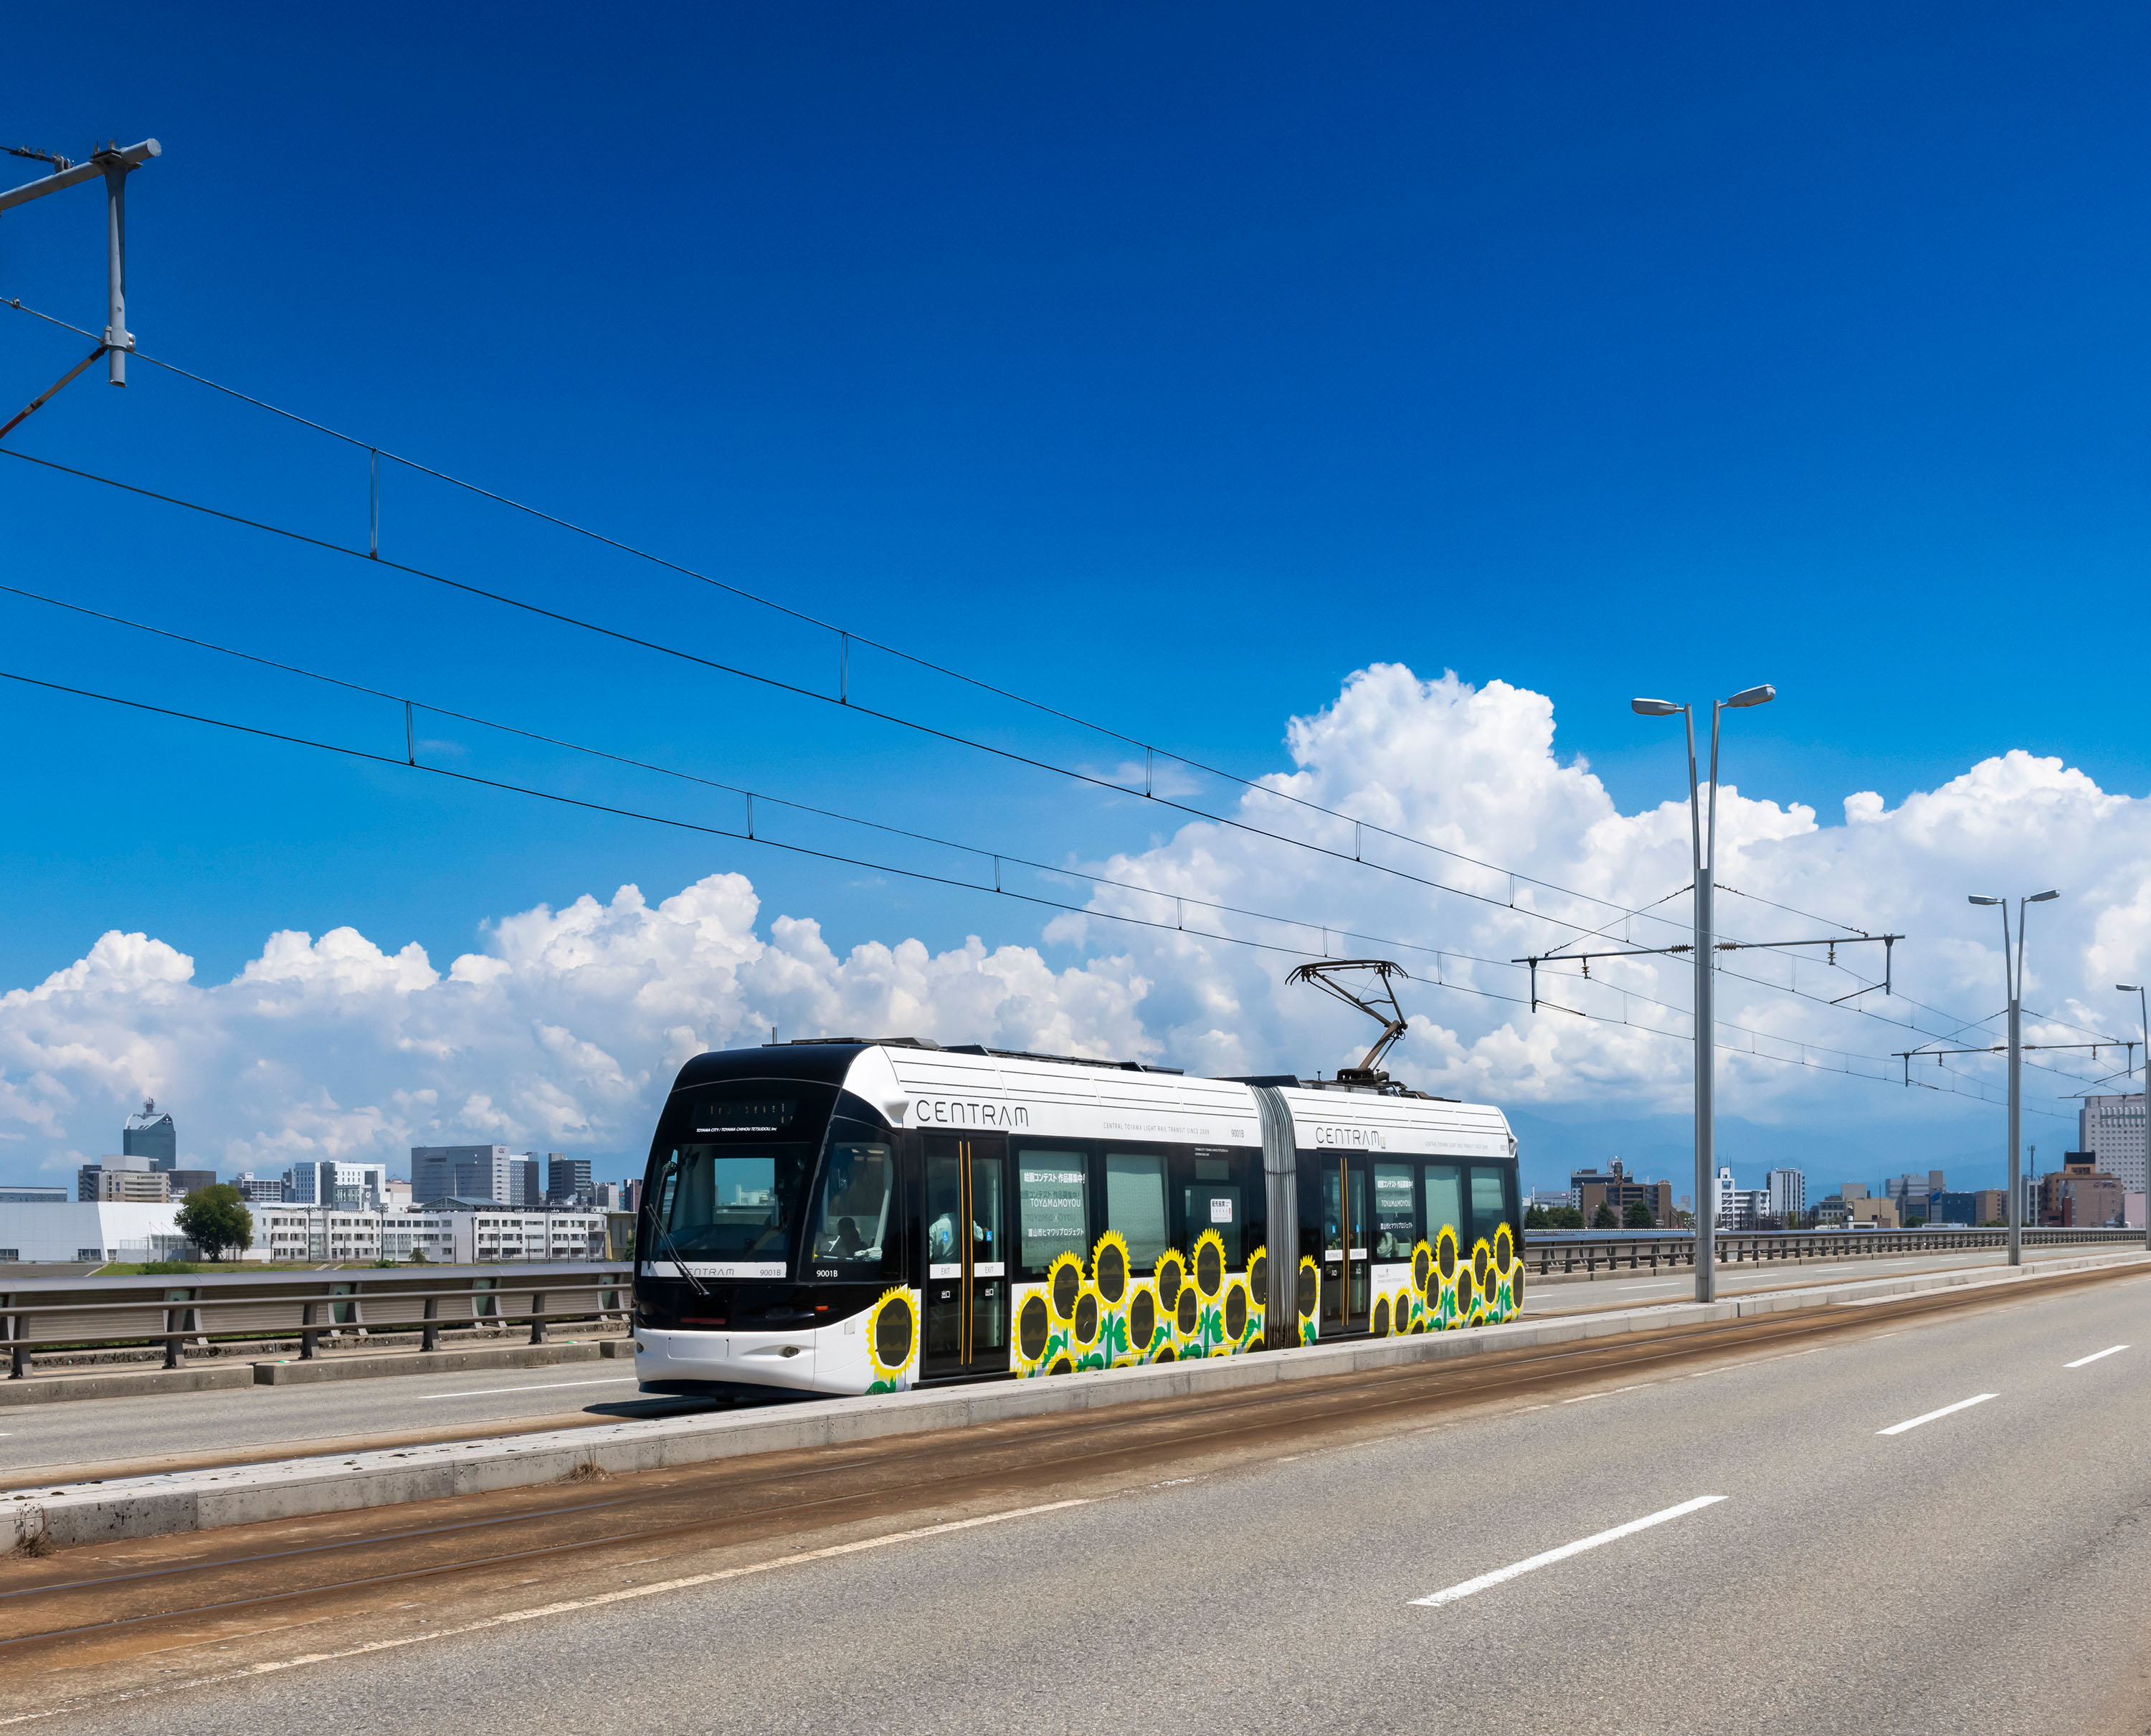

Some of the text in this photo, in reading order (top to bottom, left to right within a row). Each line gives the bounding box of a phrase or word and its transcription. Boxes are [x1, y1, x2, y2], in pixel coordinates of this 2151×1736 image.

[916, 1099, 1029, 1127] CENTRAM
[1103, 1121, 1124, 1130] CENTRAL
[1230, 1129, 1245, 1138] 9001B
[1316, 1126, 1380, 1146] CENTRAM
[1024, 1172, 1057, 1182] 絵画コンテスト
[816, 1269, 838, 1278] 9001B
[941, 1290, 951, 1299] 出口
